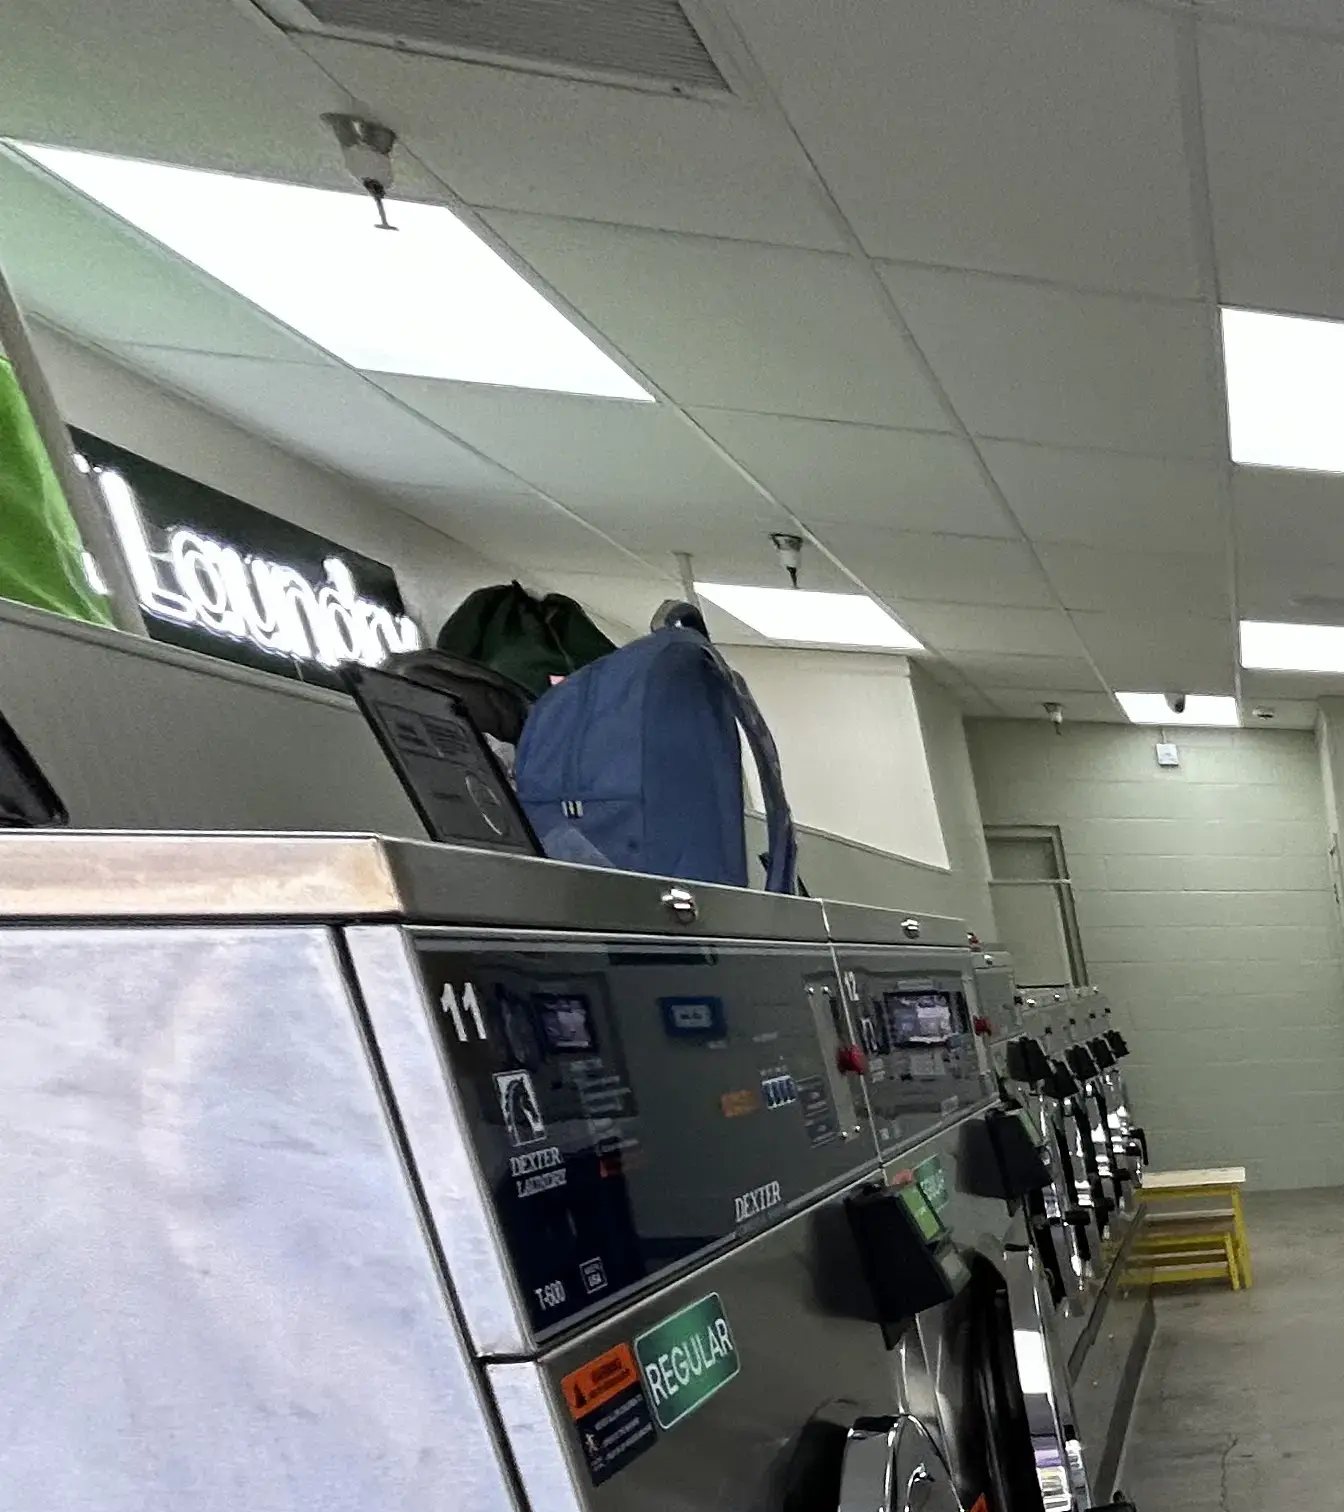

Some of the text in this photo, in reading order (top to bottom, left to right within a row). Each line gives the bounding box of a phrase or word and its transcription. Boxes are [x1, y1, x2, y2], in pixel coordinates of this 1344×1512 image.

[440, 982, 488, 1043] 11
[510, 1147, 564, 1177] DEXTER
[734, 1181, 782, 1223] DEXTER
[645, 1318, 734, 1405] REGULAR
